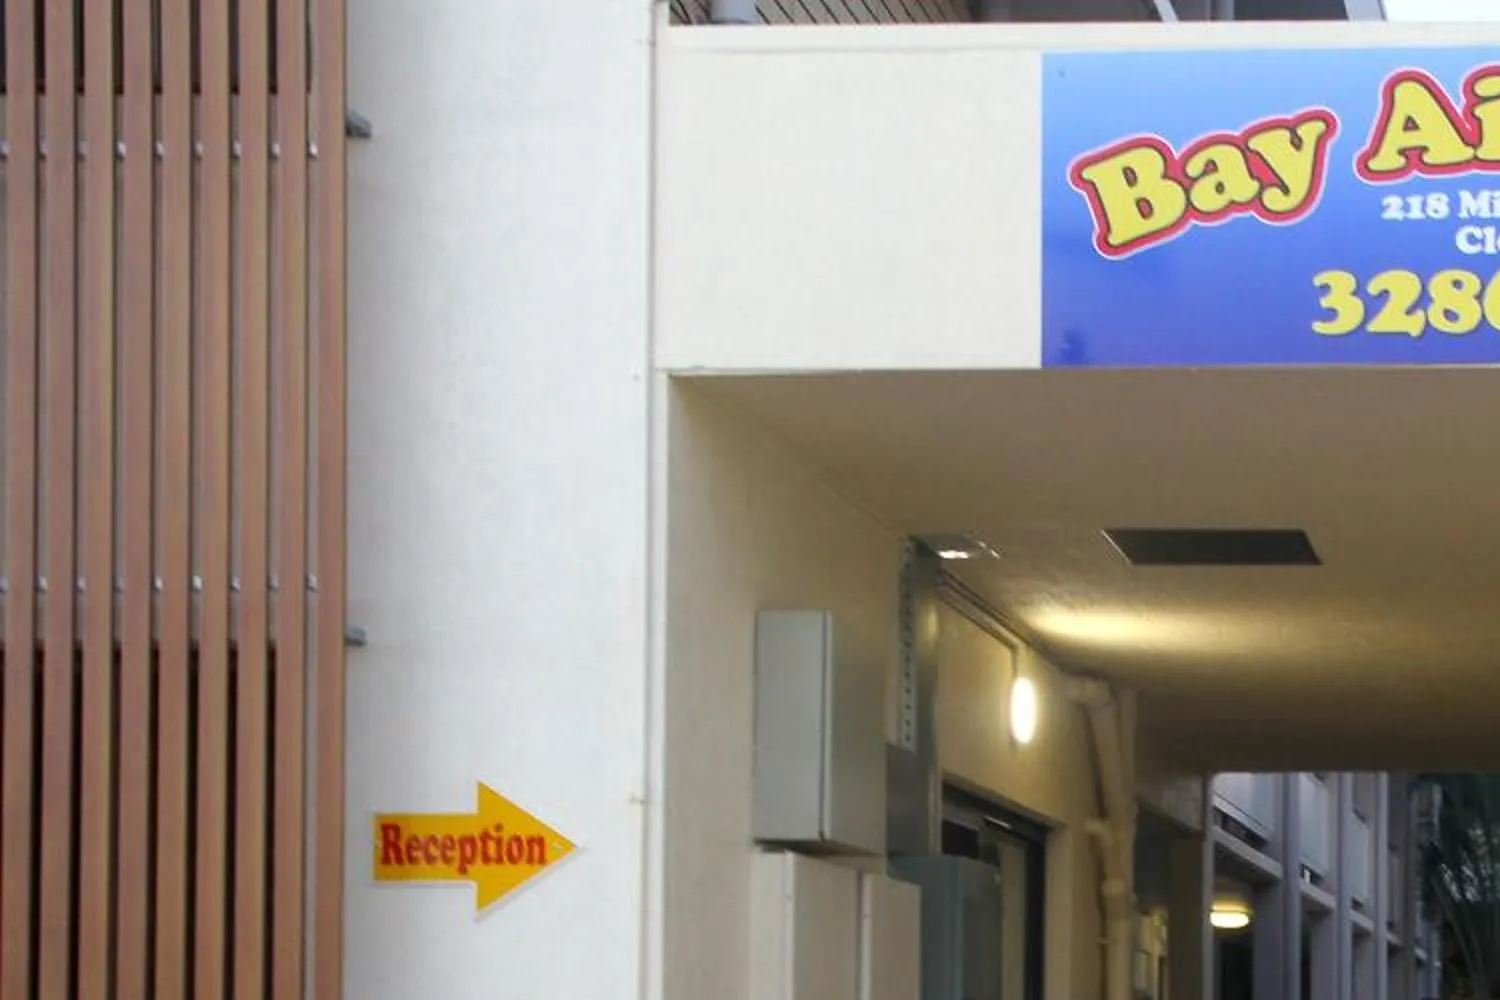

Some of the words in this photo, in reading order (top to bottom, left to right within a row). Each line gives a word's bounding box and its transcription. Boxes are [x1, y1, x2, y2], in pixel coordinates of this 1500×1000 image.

[1074, 111, 1333, 254] Bay
[1381, 192, 1450, 220] 218
[380, 823, 547, 875] Reception
